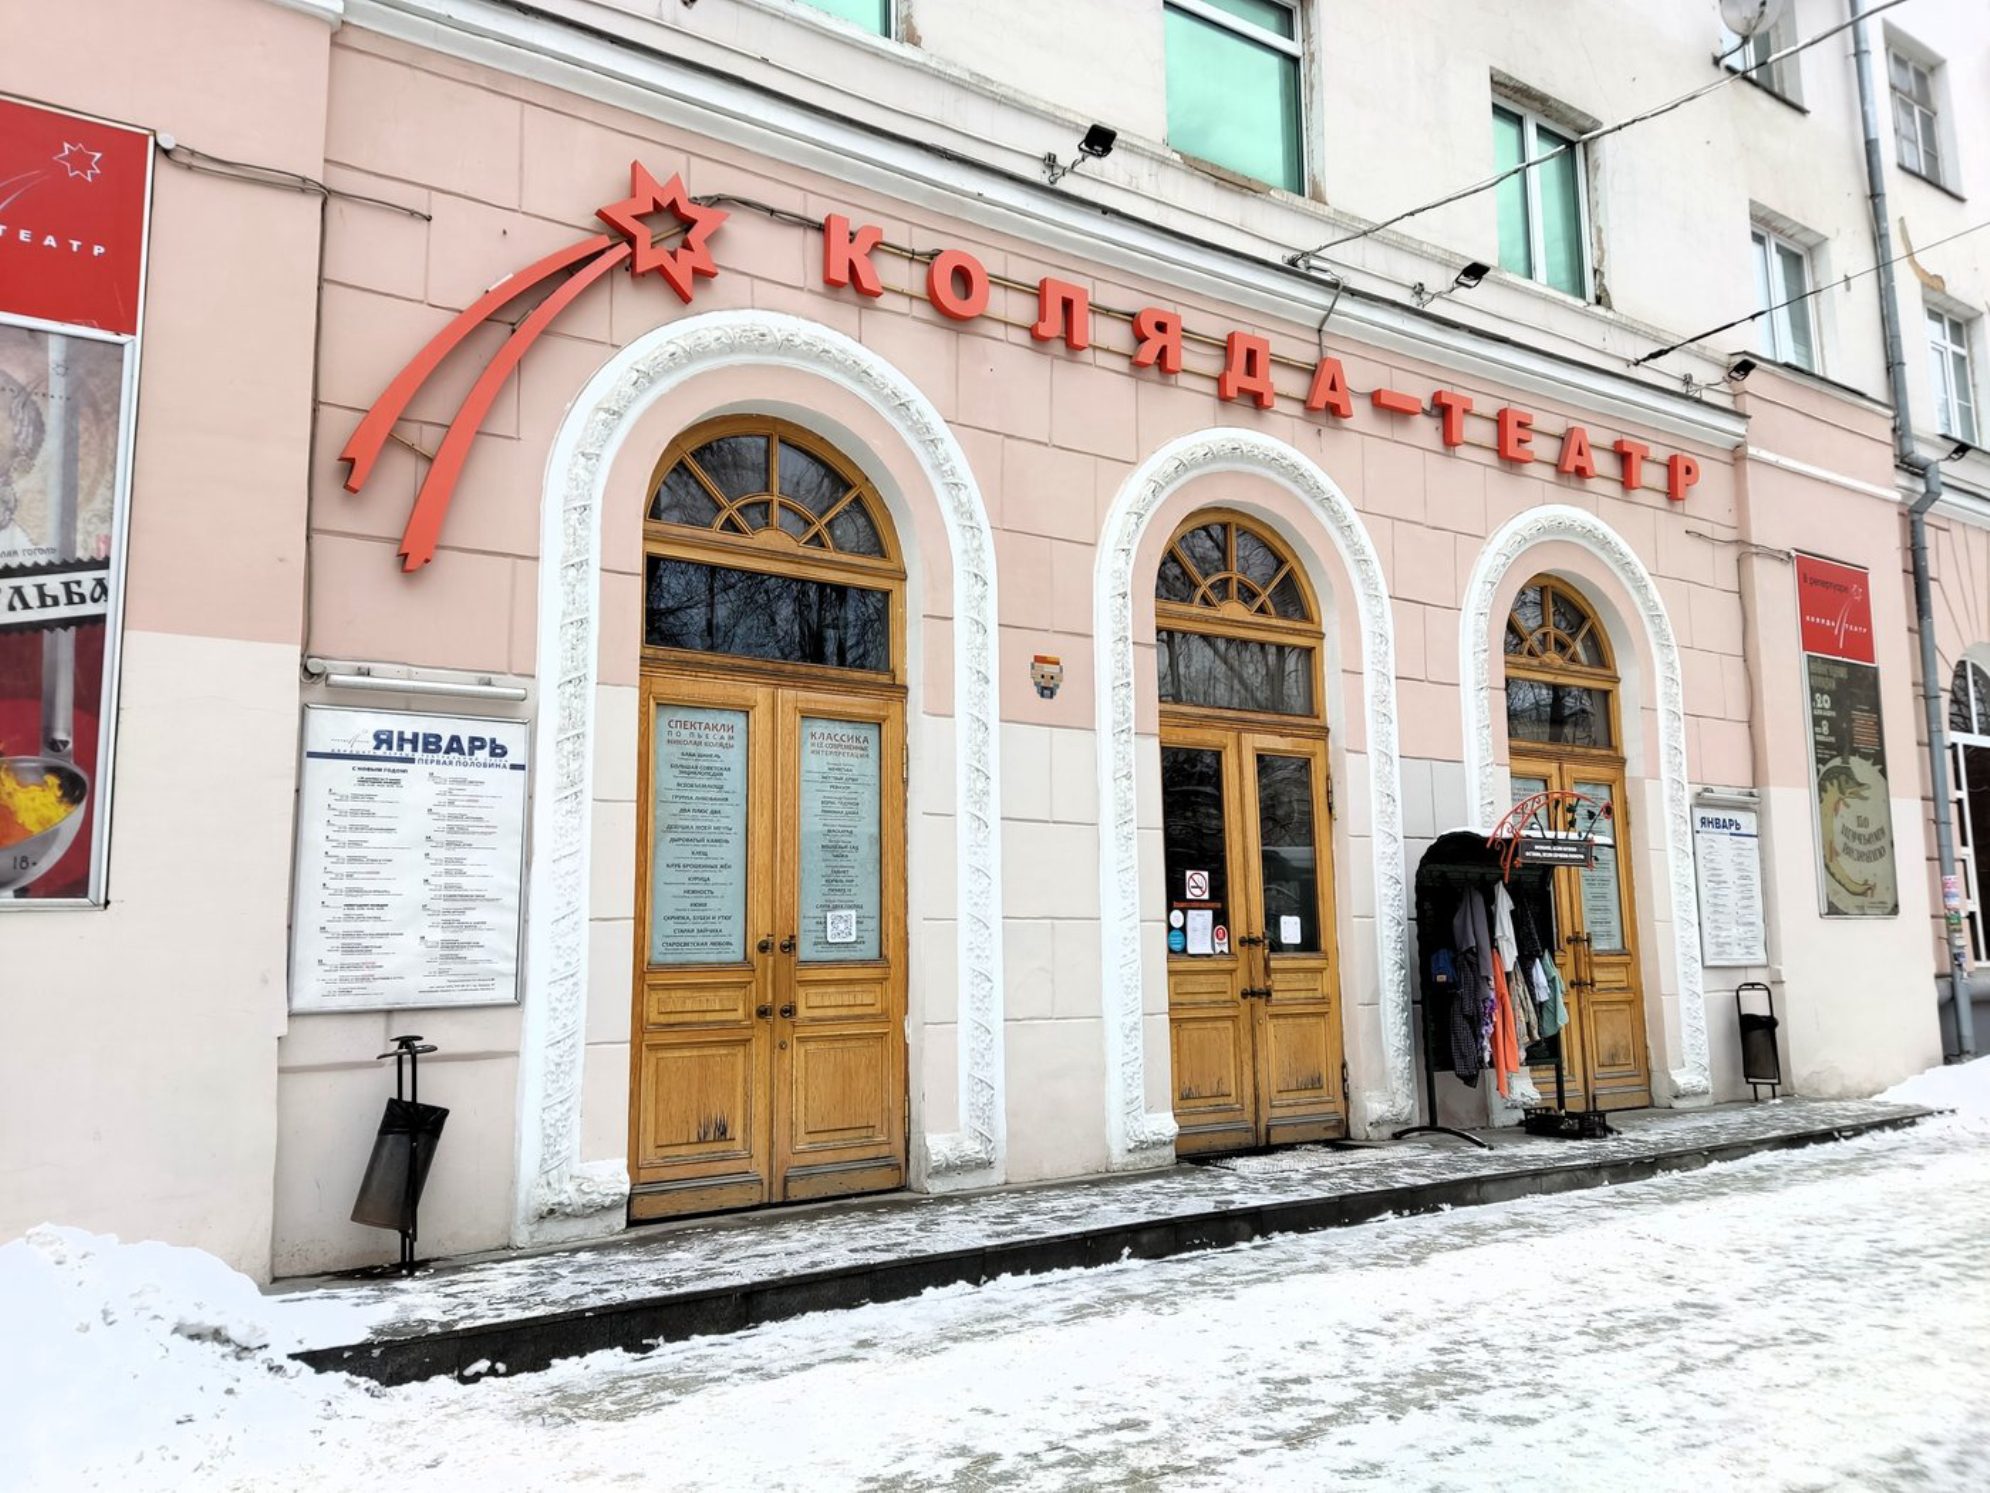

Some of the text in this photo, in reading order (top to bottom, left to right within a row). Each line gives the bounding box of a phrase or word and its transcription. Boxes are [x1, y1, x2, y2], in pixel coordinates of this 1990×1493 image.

[0, 577, 108, 612] ЛЬБА
[667, 719, 734, 733] СПЕКТАКЛИ
[667, 730, 734, 741] ПО ПЬЕСАМ
[810, 731, 869, 745] КЛАССИКА
[373, 729, 508, 758] ЯНВАРЬ
[417, 757, 508, 770] ПЕРВАЯ ПОЛОВИНА
[1700, 816, 1741, 830] ЯНВАРЬ
